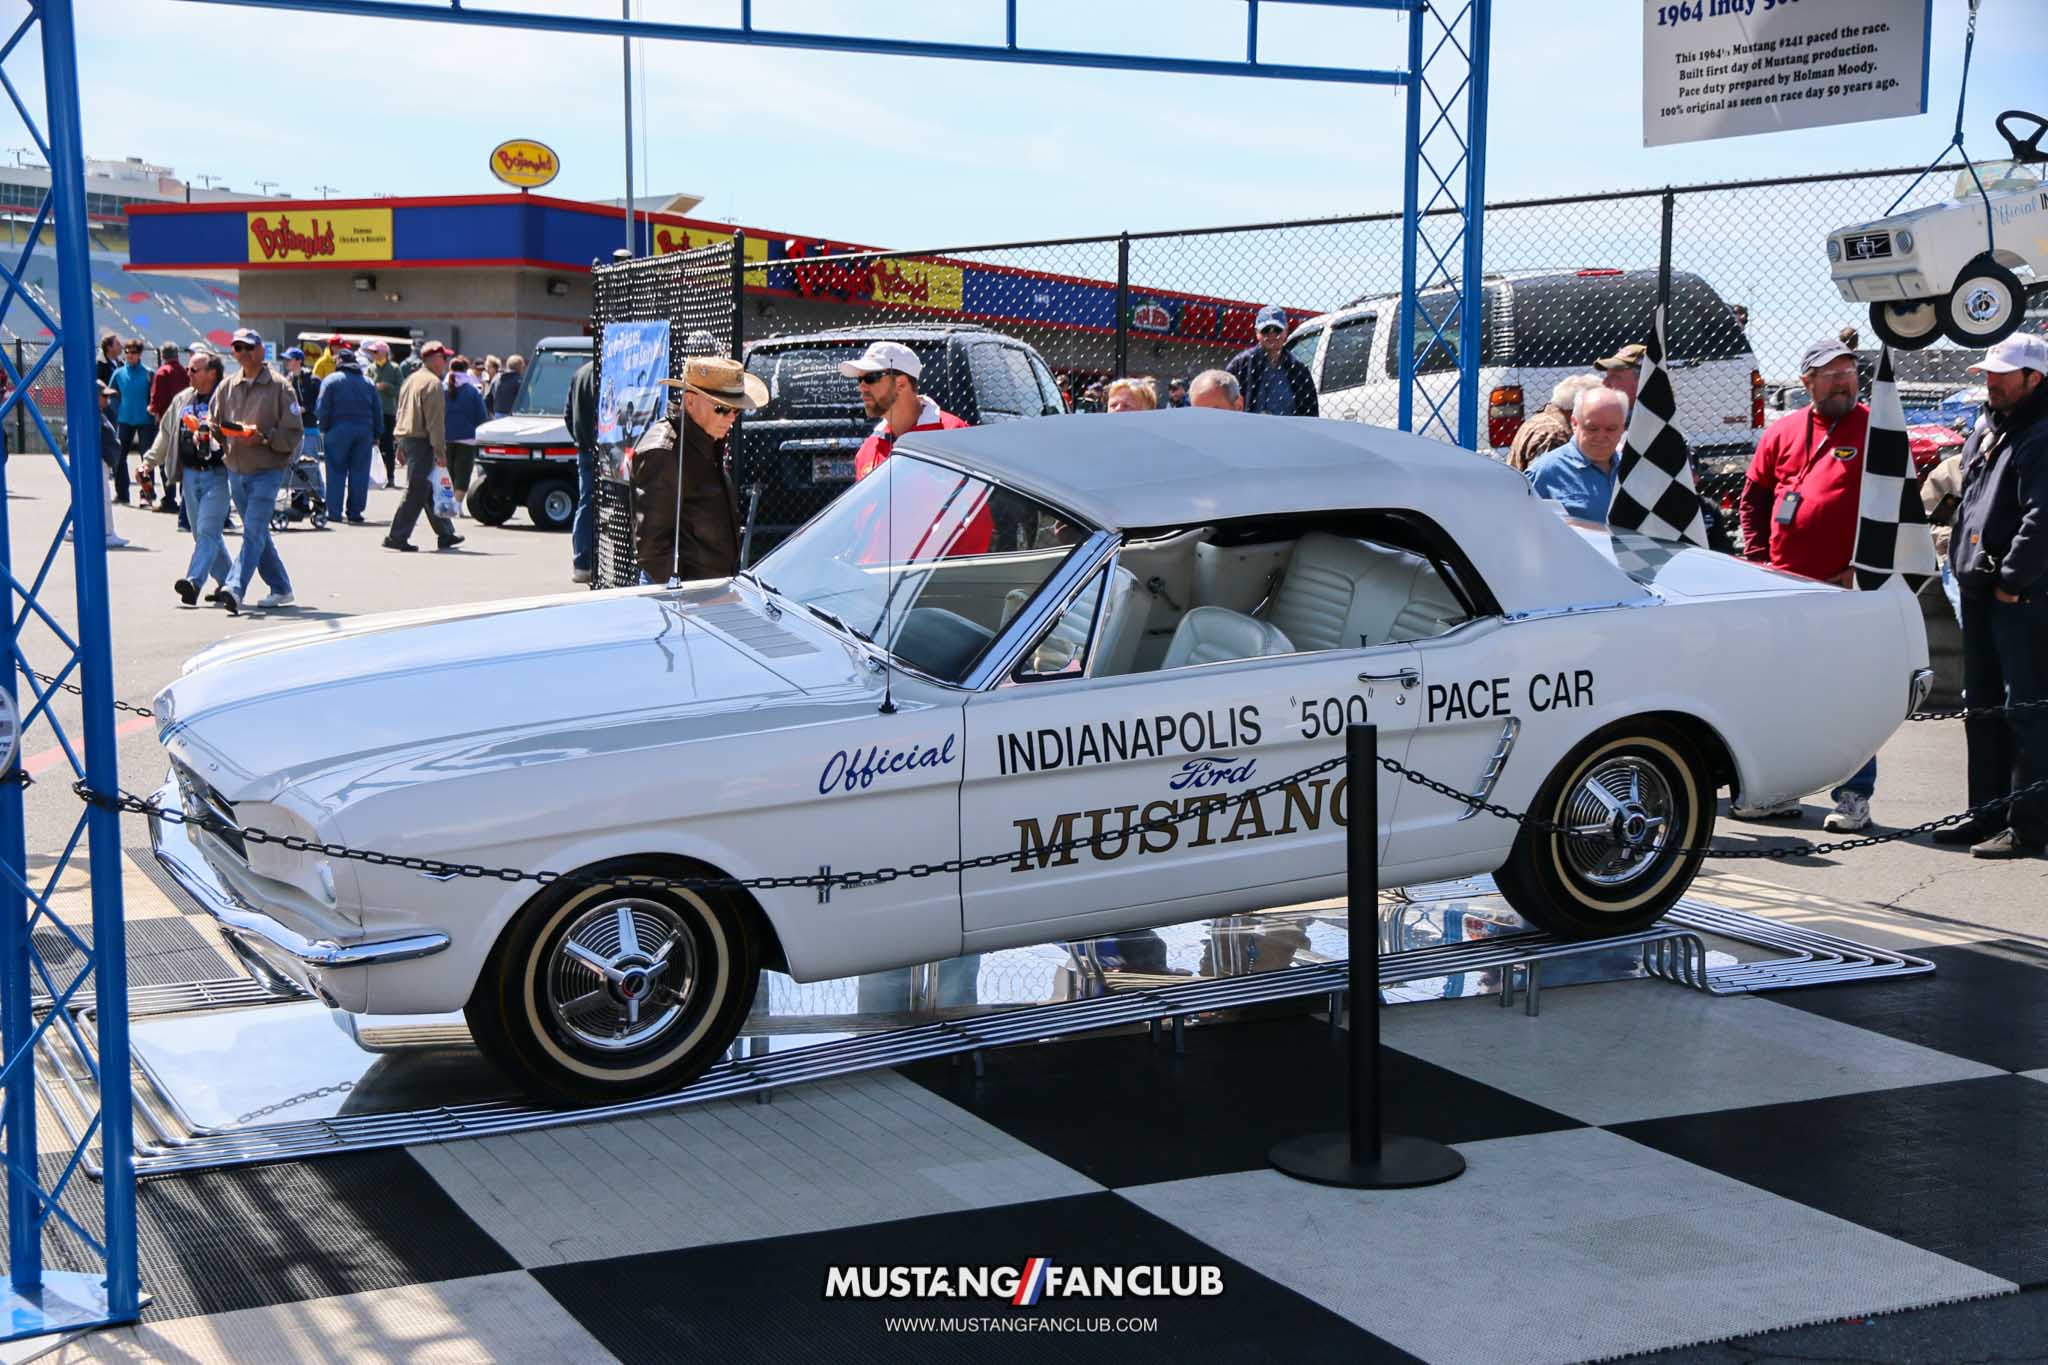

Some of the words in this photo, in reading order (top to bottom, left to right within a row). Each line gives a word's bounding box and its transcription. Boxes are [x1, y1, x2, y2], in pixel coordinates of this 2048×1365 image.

[1657, 0, 1703, 27] 1964
[1675, 51, 1696, 64] This
[1733, 41, 1777, 56] Mustang
[1779, 35, 1803, 48] #241
[1806, 27, 1838, 46] paced
[1841, 25, 1859, 38] the
[1862, 22, 1890, 35] race.
[1679, 68, 1704, 81] Built
[1706, 65, 1728, 77] first
[1731, 63, 1749, 74] day
[1751, 58, 1762, 70] of
[1765, 53, 1809, 68] Mustang
[1812, 43, 1878, 63] production.
[1661, 104, 1684, 117] 100%
[1686, 99, 1725, 114] original
[1727, 98, 1738, 108] as
[1740, 97, 1762, 107] seen
[1764, 94, 1778, 104] on
[1780, 91, 1802, 102] race
[1805, 86, 1825, 99] day
[1828, 84, 1840, 97] 50
[1842, 81, 1873, 96] years
[1875, 78, 1899, 91] ago.
[1679, 87, 1700, 98] Pace
[1703, 83, 1725, 94] duty
[1728, 74, 1775, 93] prepared
[1778, 74, 1791, 85] by
[1793, 68, 1835, 82] Holman
[1838, 60, 1877, 76] Moody.
[819, 733, 956, 794] Official
[997, 705, 1262, 775] INDIANAPOLIS
[1427, 677, 1511, 722] PACE
[1528, 669, 1595, 713] CAR
[1169, 756, 1257, 790] Ford
